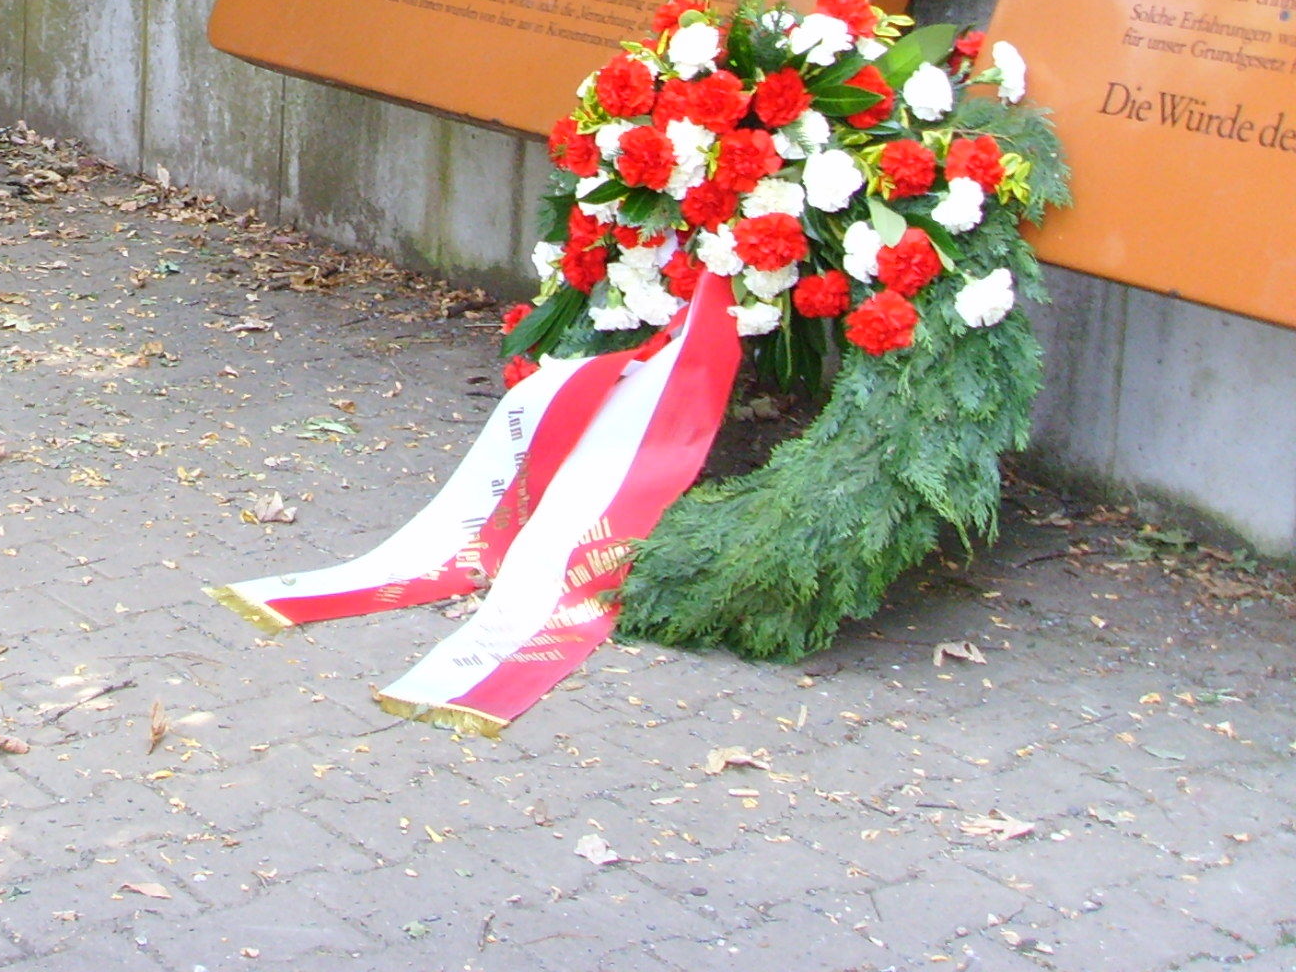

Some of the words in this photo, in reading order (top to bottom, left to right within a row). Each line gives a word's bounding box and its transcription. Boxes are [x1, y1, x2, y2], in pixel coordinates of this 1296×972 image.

[1130, 3, 1176, 27] Solche
[1180, 11, 1273, 44] Erfahrungen
[1122, 27, 1144, 47] für
[1147, 38, 1187, 55] unser
[1191, 40, 1286, 71] Grundgesetz
[1096, 81, 1153, 122] Die
[1158, 90, 1254, 143] Würde
[1258, 111, 1296, 153] de
[508, 406, 525, 441] Zum
